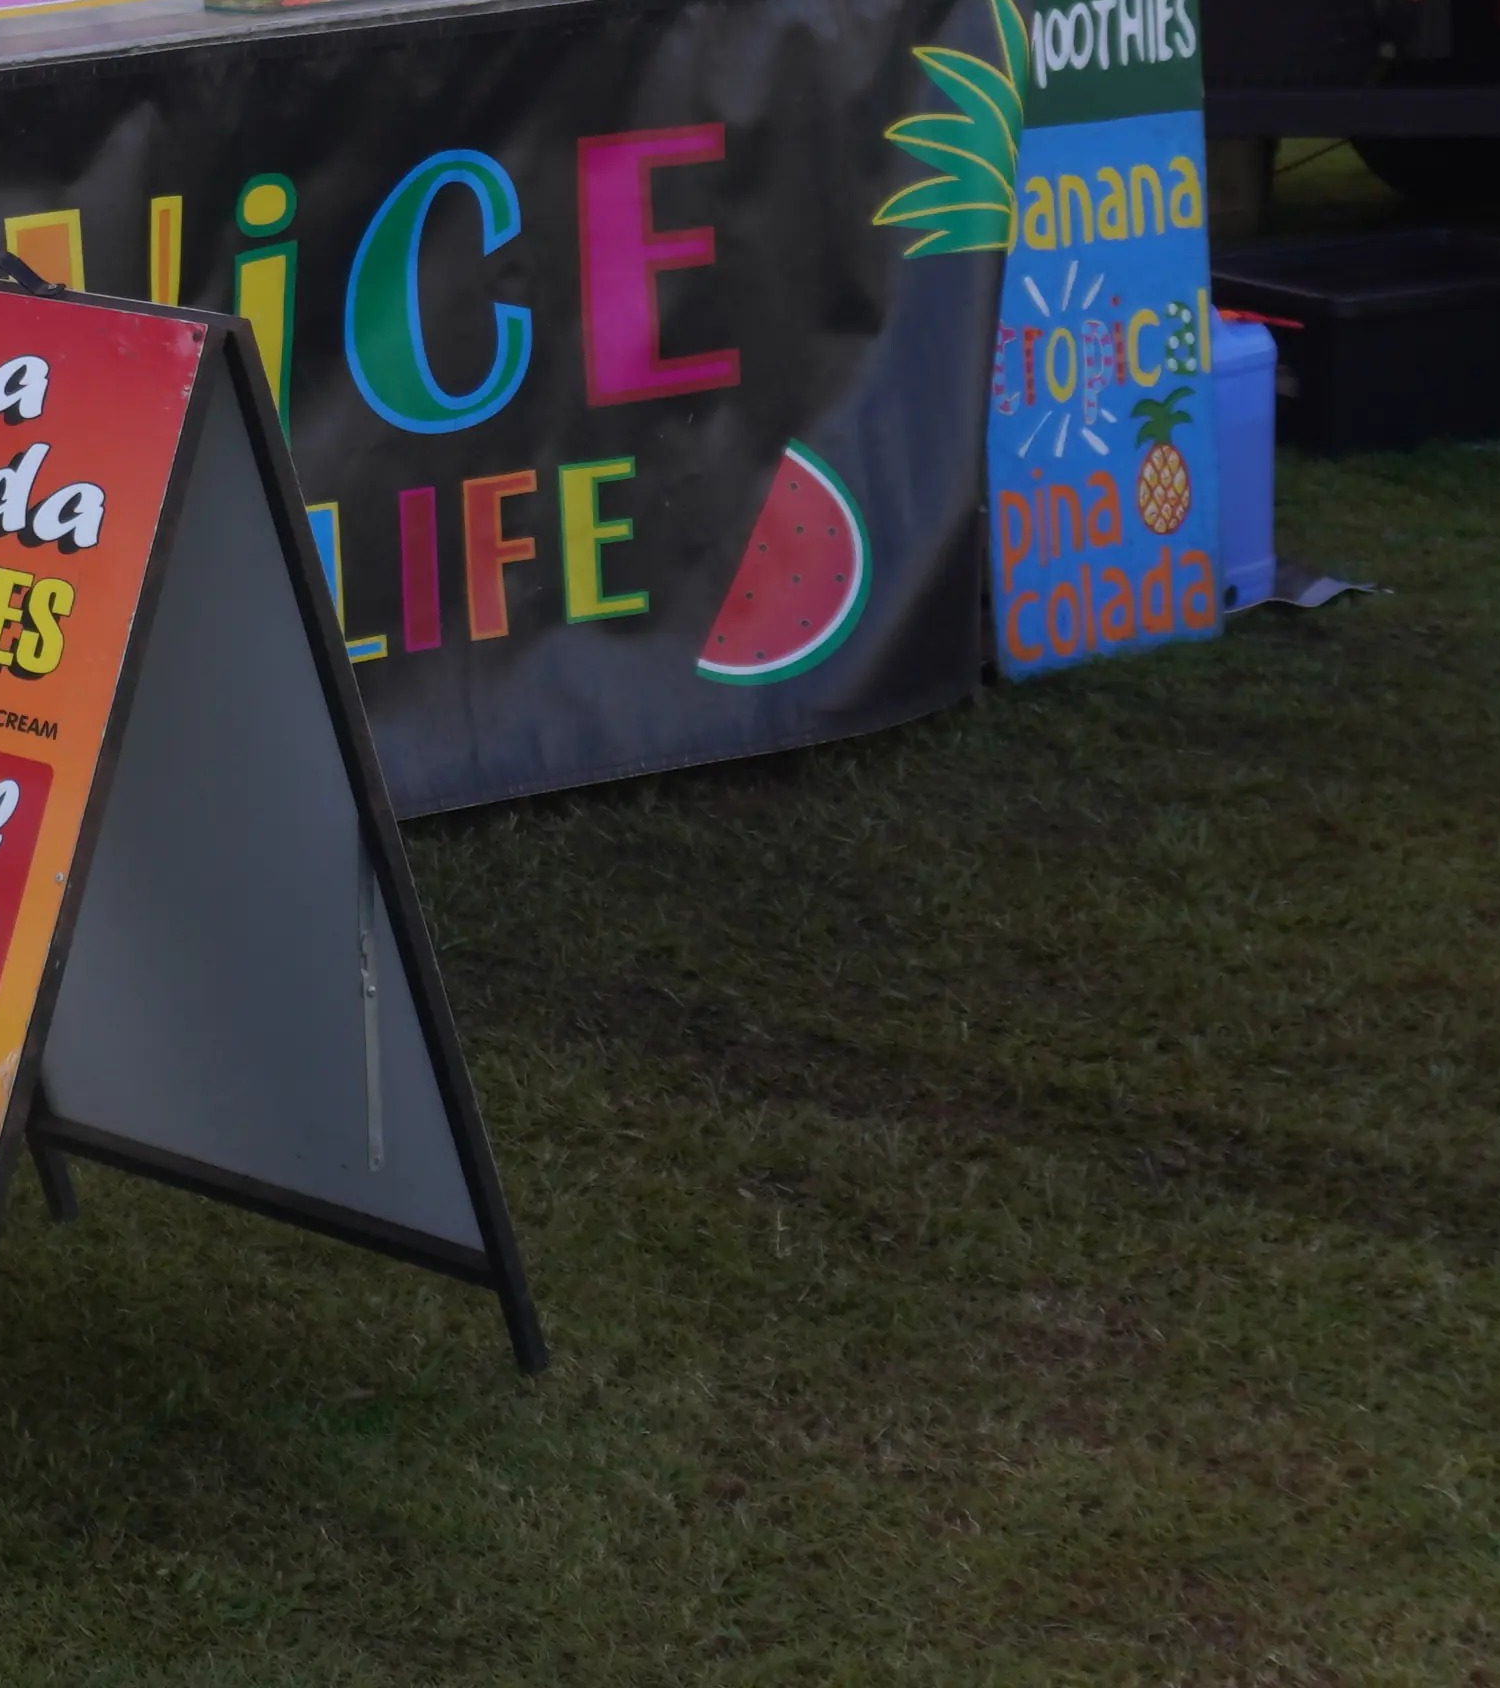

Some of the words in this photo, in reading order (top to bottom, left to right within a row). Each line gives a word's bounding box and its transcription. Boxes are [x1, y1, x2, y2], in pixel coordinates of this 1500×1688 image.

[991, 286, 1212, 425] tropical
[999, 468, 1123, 594] pina
[1006, 546, 1216, 663] colada
